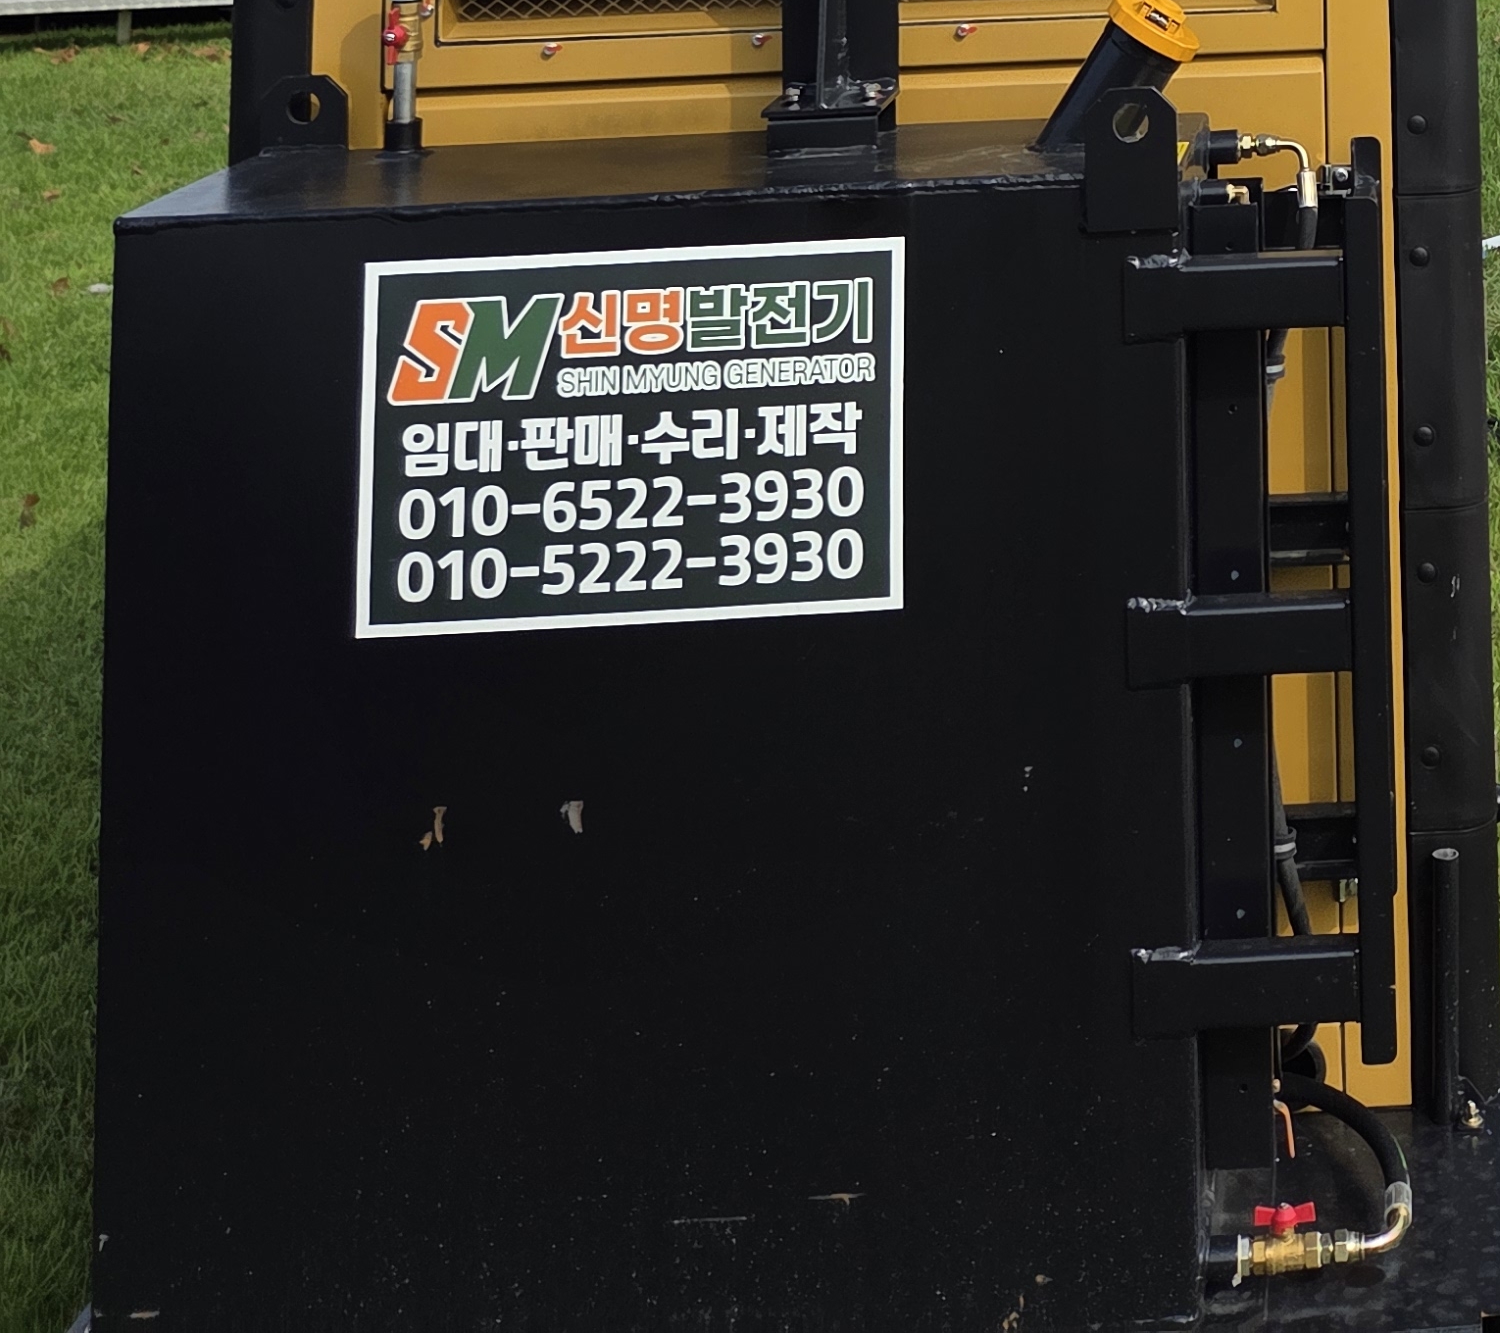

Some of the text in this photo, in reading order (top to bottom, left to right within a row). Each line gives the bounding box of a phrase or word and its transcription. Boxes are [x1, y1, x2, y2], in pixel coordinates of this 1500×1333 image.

[388, 294, 564, 406] SM
[559, 278, 873, 357] 신명발전기
[558, 354, 875, 397] SHIN MYUNG GENERATOR
[398, 467, 864, 539] 010-6522-3930
[397, 529, 864, 602] 010-5222-3930
